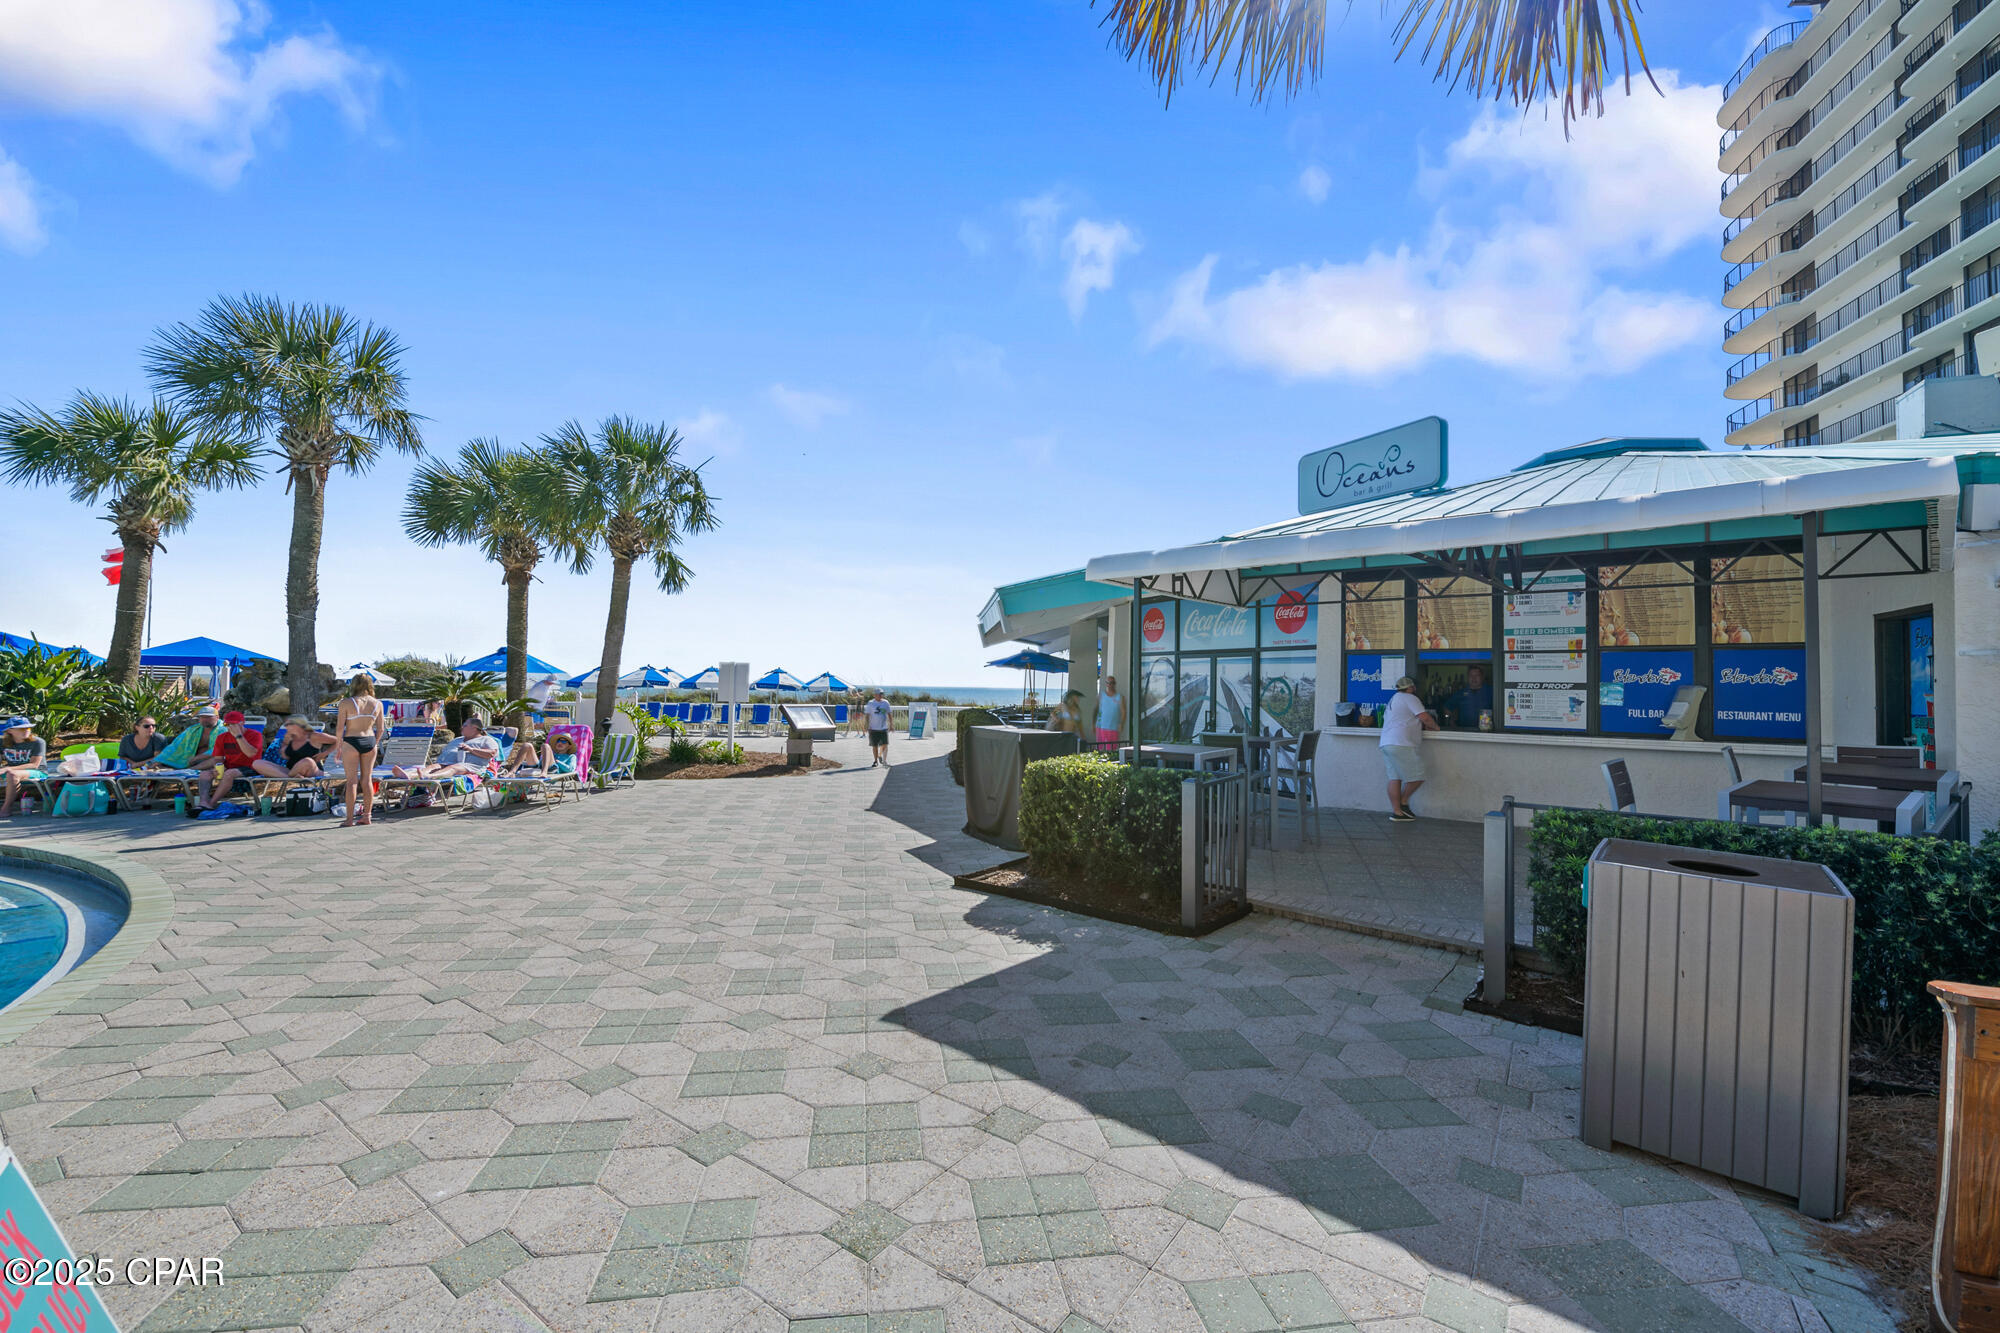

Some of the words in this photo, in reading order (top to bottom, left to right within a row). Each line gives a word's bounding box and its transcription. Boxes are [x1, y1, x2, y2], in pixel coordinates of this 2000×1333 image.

[1316, 451, 1416, 498] Oceans
[1353, 488, 1365, 497] bar
[1376, 480, 1393, 492] grill
[1628, 708, 1648, 718] FULL
[1648, 709, 1665, 719] BAR
[1717, 710, 1774, 721] RESTAURANT
[1775, 712, 1802, 722] MENU
